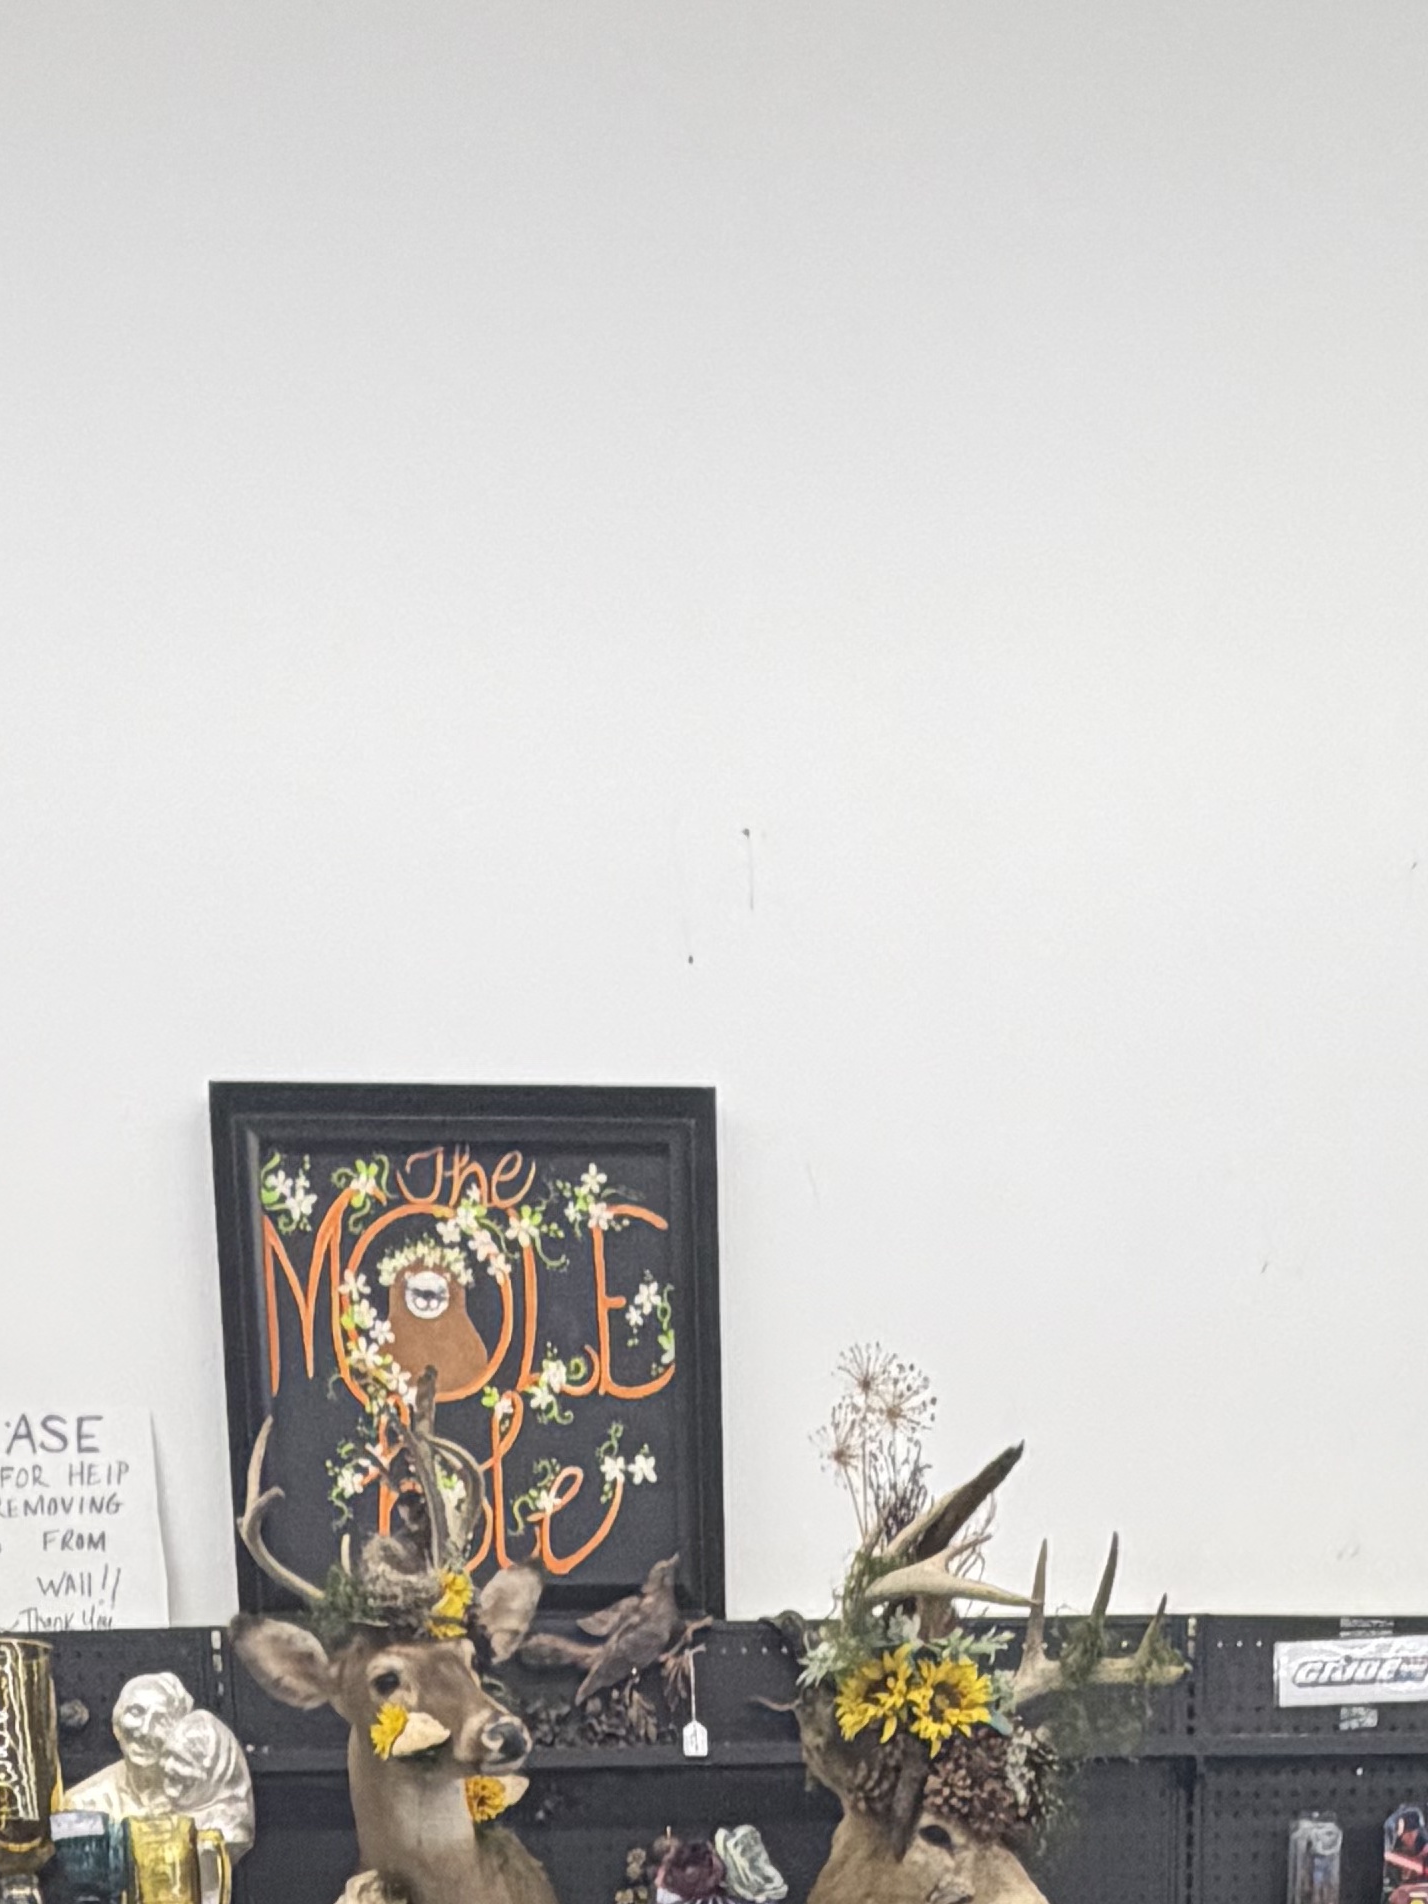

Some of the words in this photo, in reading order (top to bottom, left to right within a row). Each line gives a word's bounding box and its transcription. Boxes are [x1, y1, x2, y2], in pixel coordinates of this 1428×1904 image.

[397, 1144, 535, 1209] The
[262, 1187, 674, 1403] MOLE
[0, 1464, 50, 1488] FOR
[43, 1529, 106, 1552] FROM
